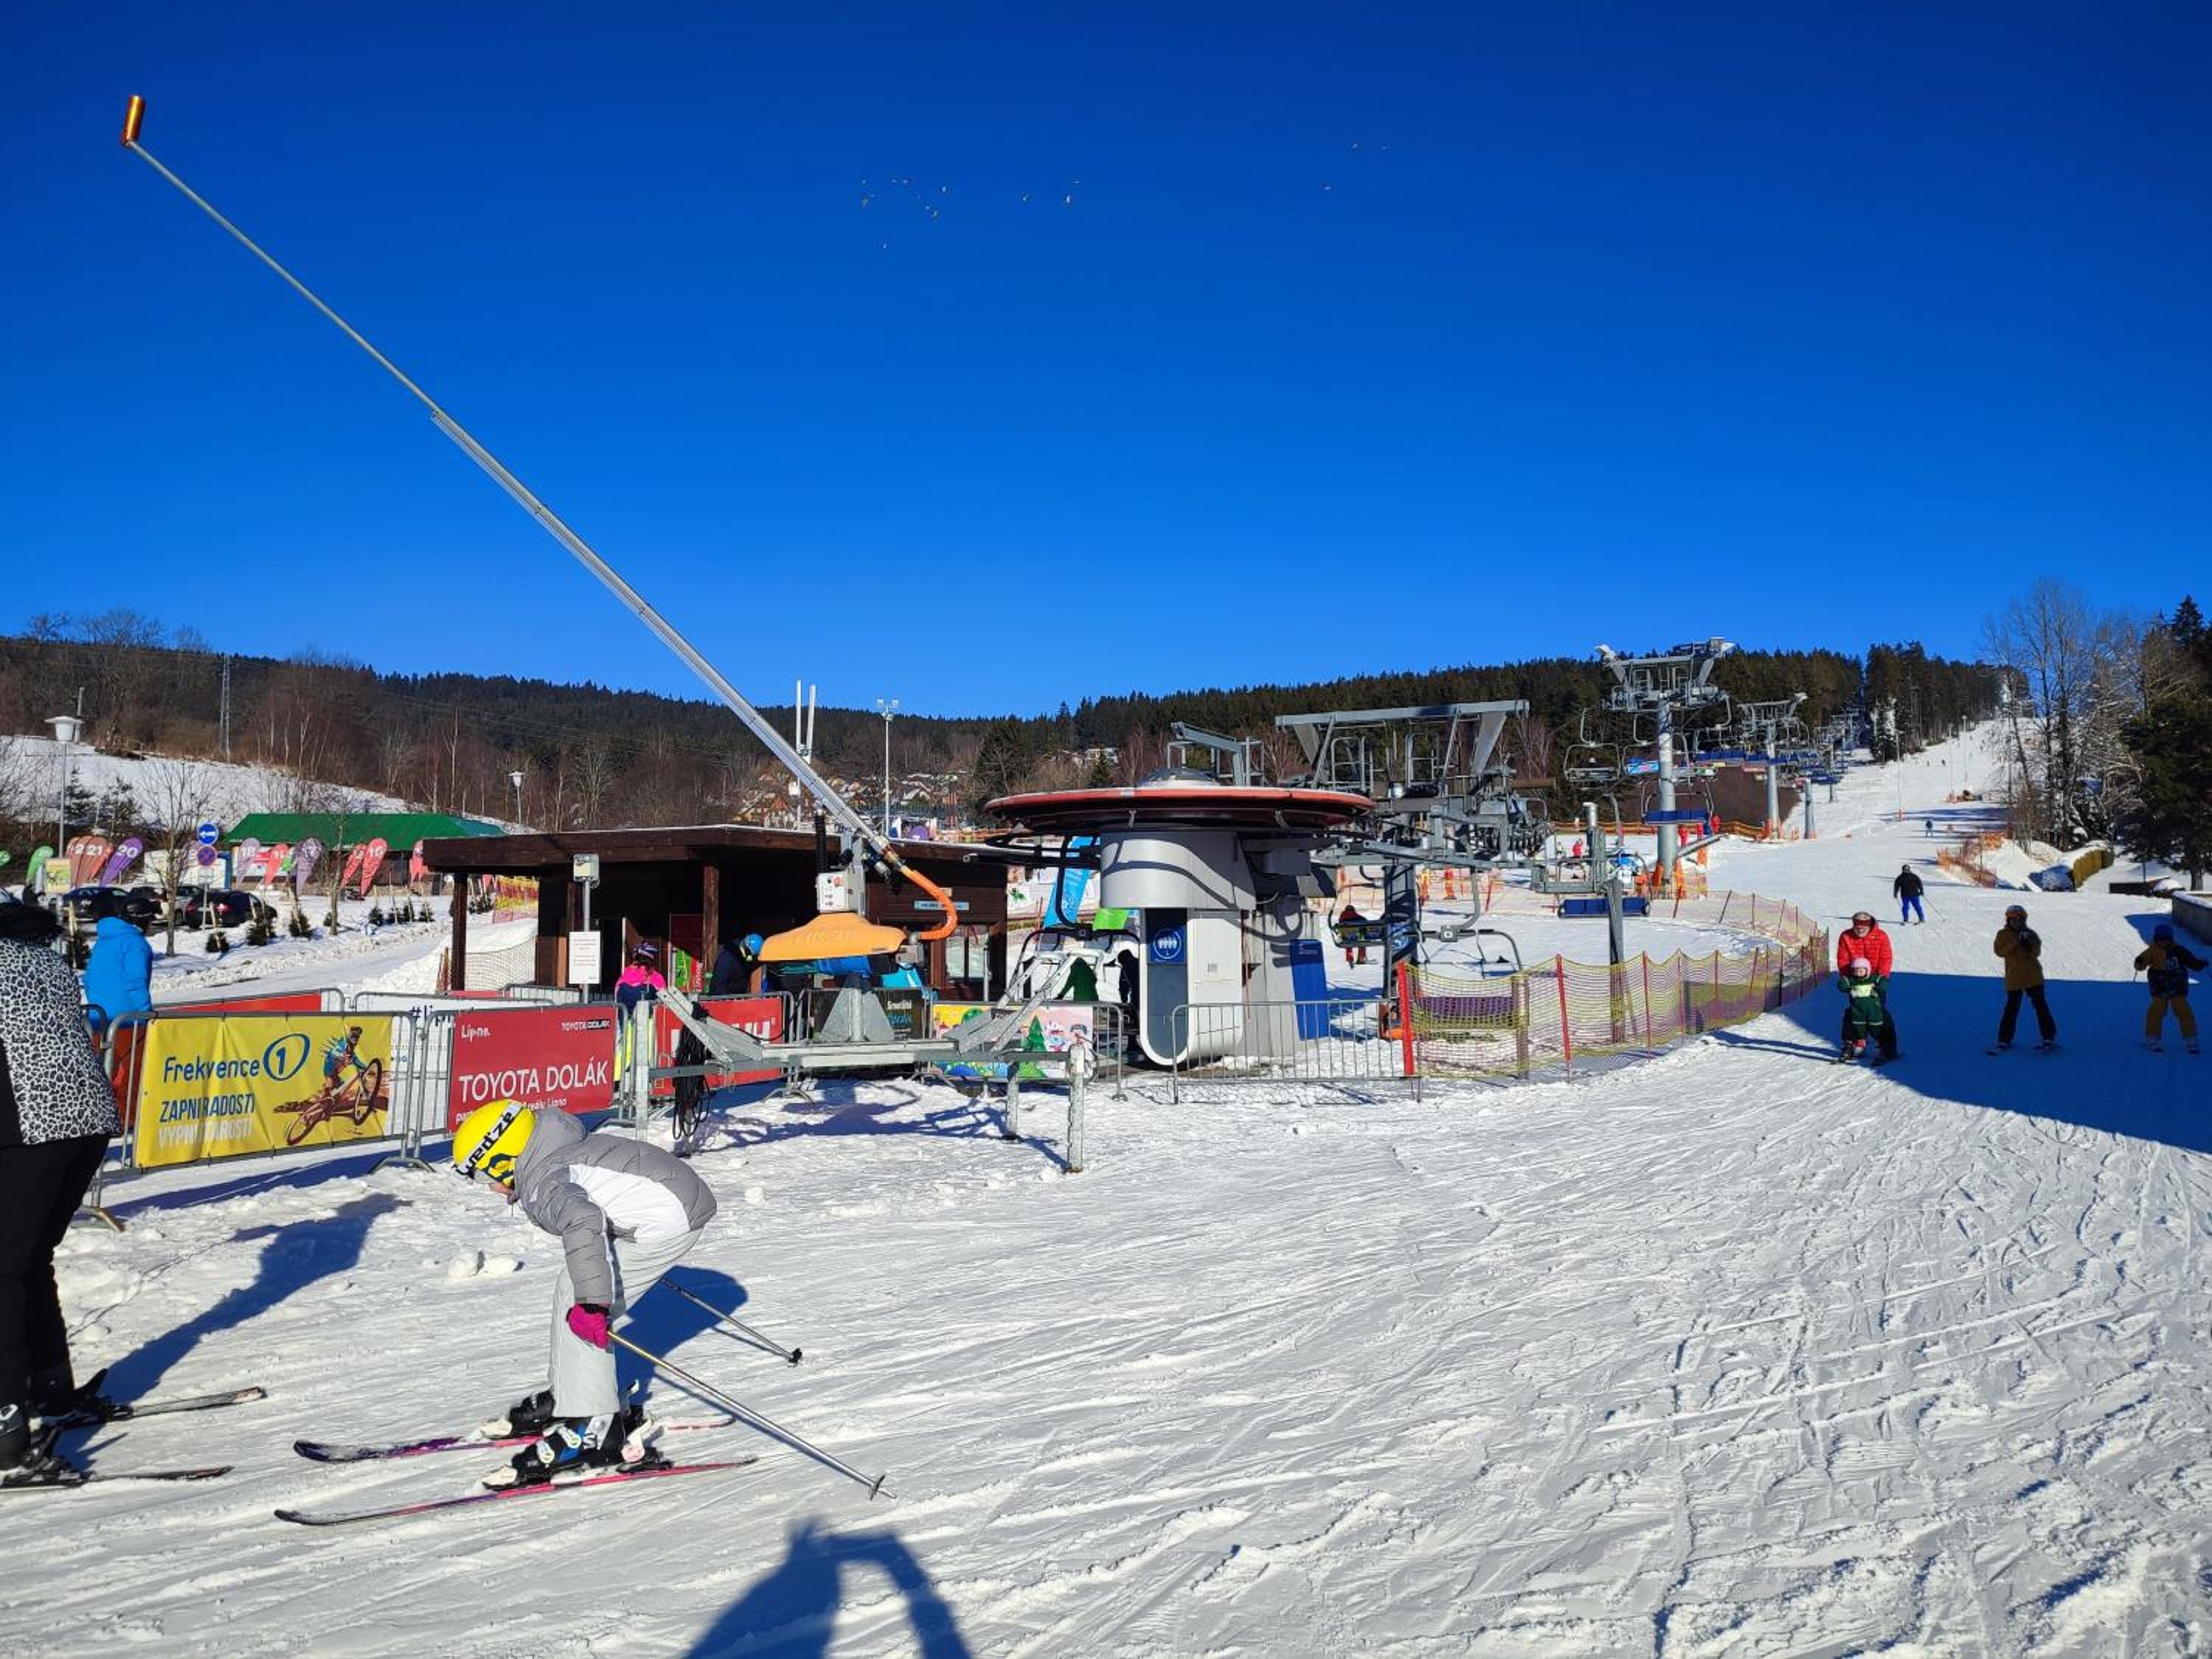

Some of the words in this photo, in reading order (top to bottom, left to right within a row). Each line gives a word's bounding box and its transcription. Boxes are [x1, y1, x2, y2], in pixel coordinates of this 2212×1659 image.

[87, 844, 103, 855] 21
[117, 844, 139, 858] 20
[164, 1055, 260, 1083] Frekvence
[458, 1068, 540, 1103] TOYOTA
[546, 1057, 608, 1093] DOLÁK
[159, 1099, 202, 1123] ZAPNI
[203, 1093, 256, 1119] RADOSTI
